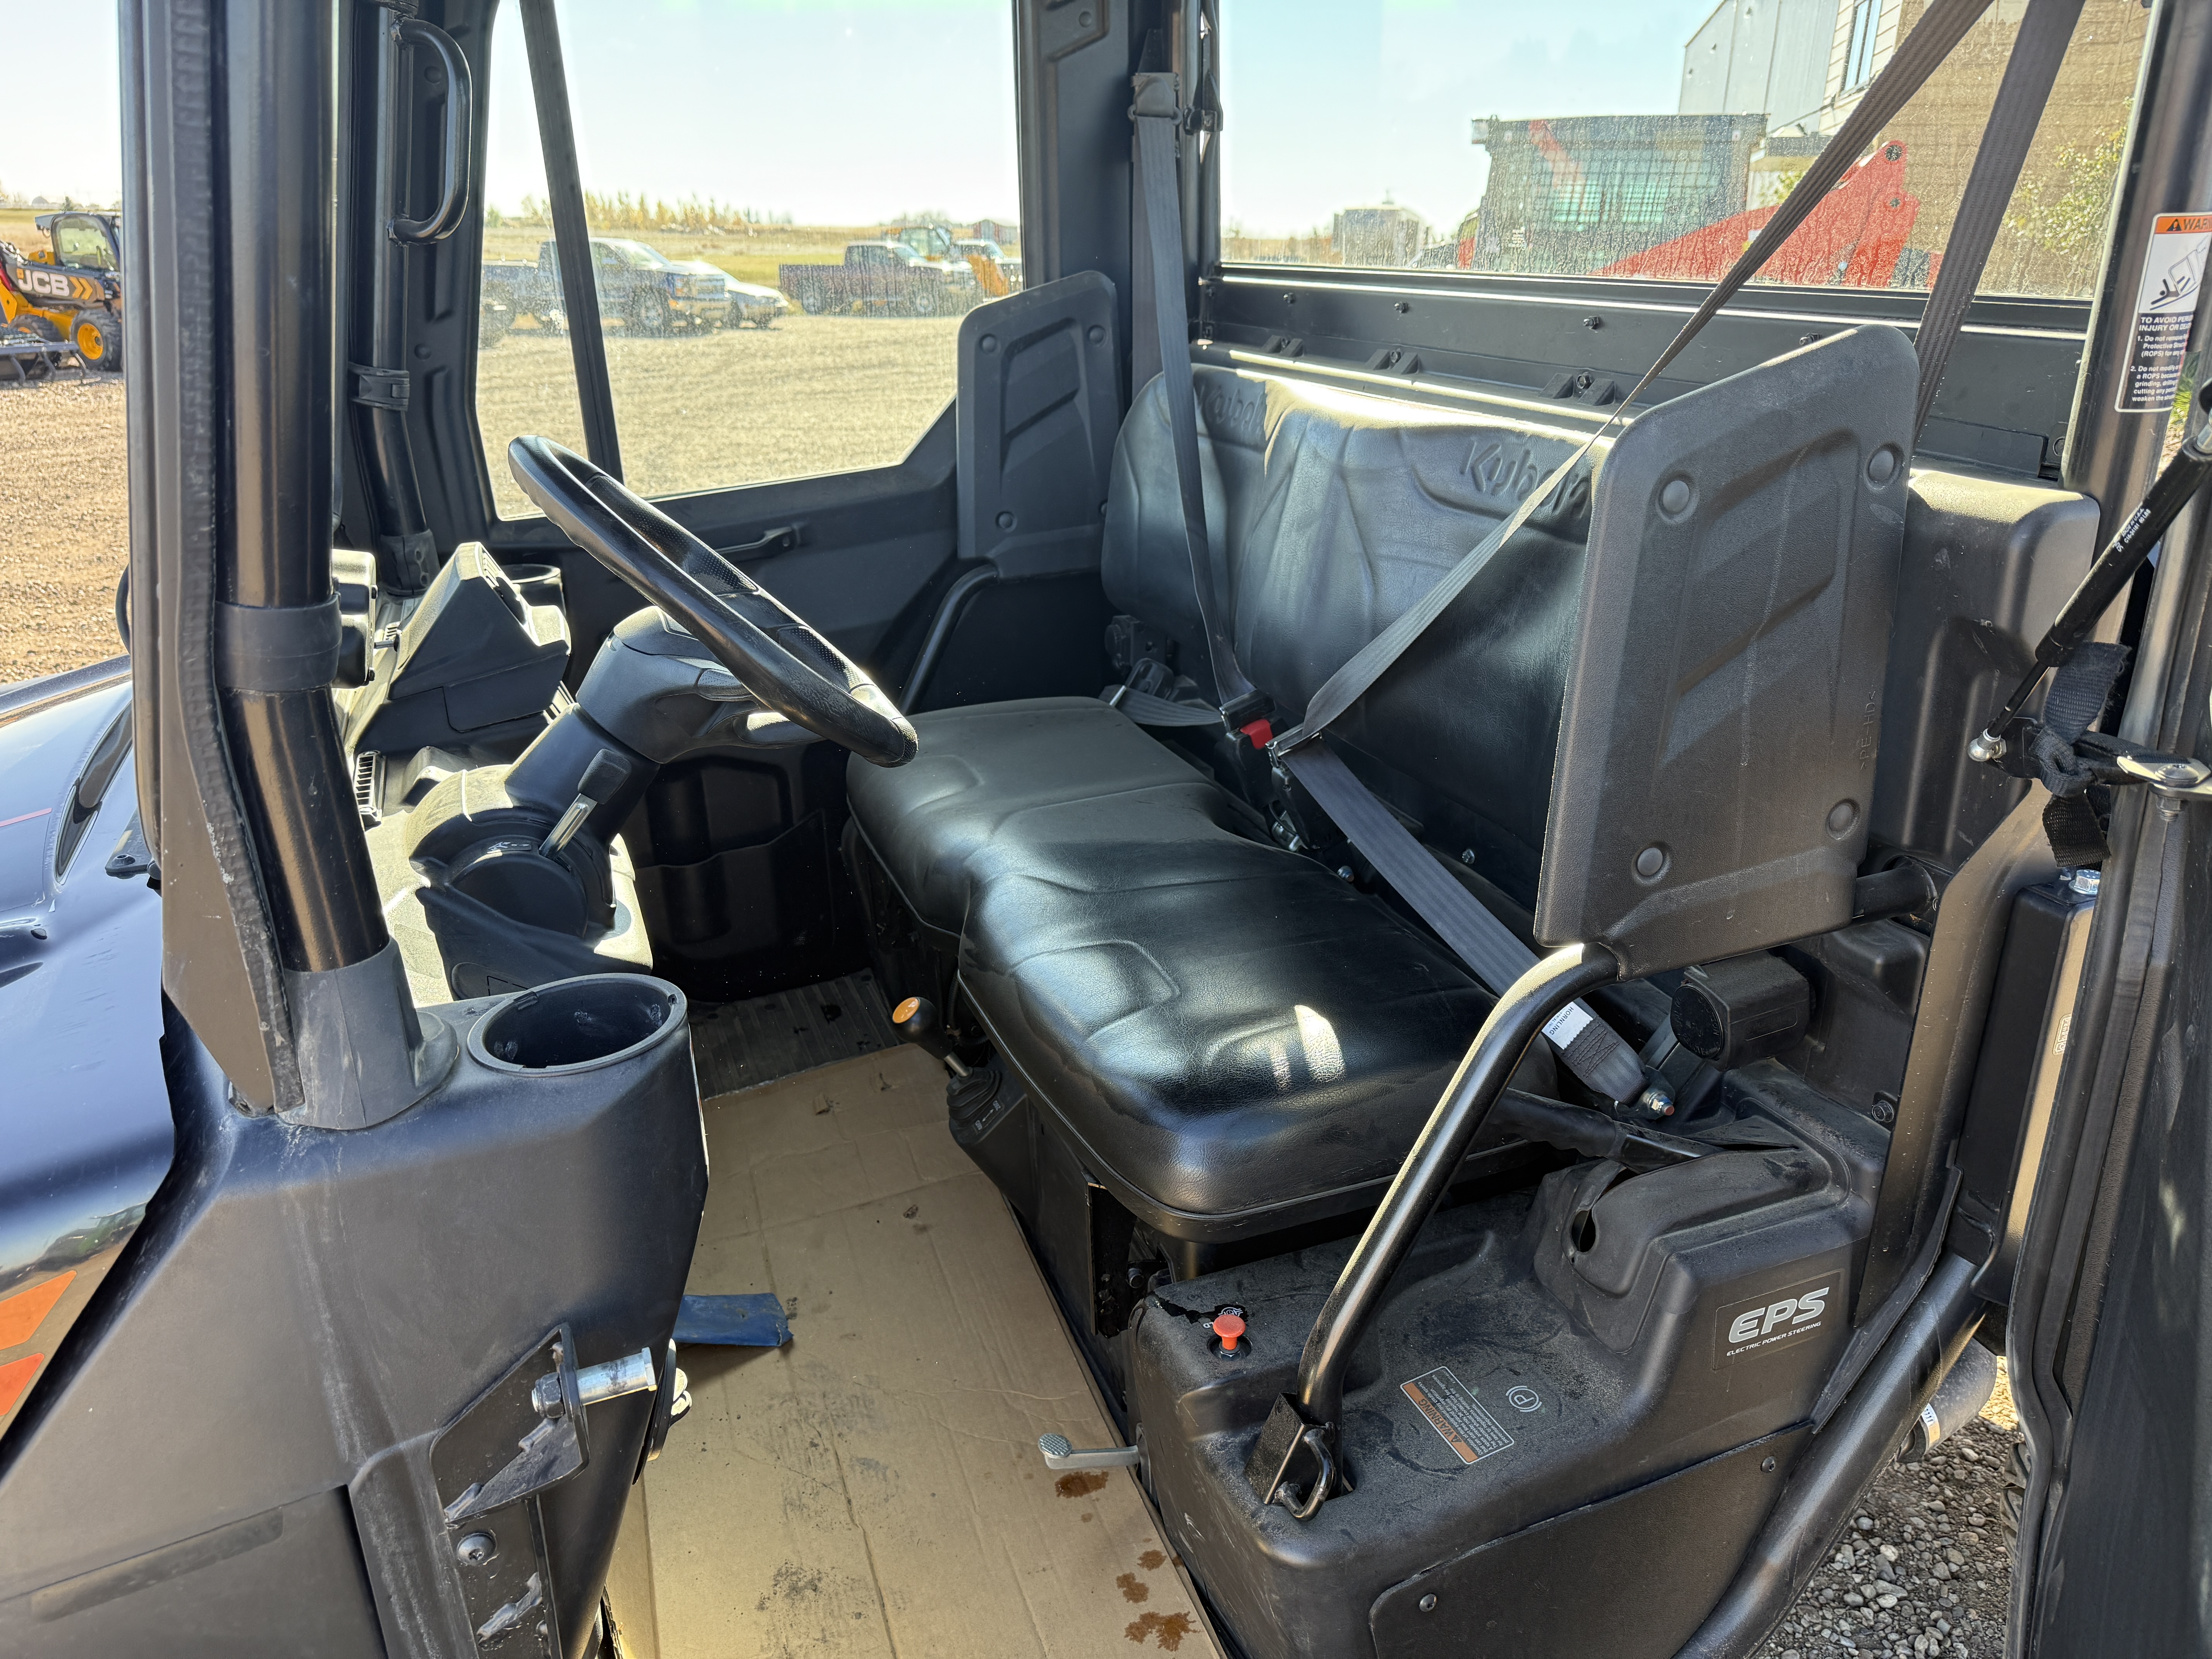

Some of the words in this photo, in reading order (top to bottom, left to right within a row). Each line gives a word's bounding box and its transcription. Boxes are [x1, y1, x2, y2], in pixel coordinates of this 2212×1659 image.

[2184, 218, 2212, 230] WARN
[17, 269, 70, 297] JCB
[1549, 1006, 1574, 1035] HORNLING
[1728, 1286, 1830, 1343] EPS
[1726, 1341, 1762, 1356] ELECTRIC
[1762, 1333, 1787, 1345] POWER
[1787, 1321, 1821, 1336] STEERING
[1449, 1411, 1462, 1423] around
[1456, 1403, 1469, 1415] contact
[1417, 1398, 1455, 1437] WARNING
[1442, 1410, 1459, 1427] equipment
[1467, 1415, 1479, 1427] should
[1467, 1430, 1476, 1438] start
[1477, 1426, 1492, 1441] operator
[1480, 1436, 1491, 1446] spark
[1466, 1437, 1484, 1455] Operation
